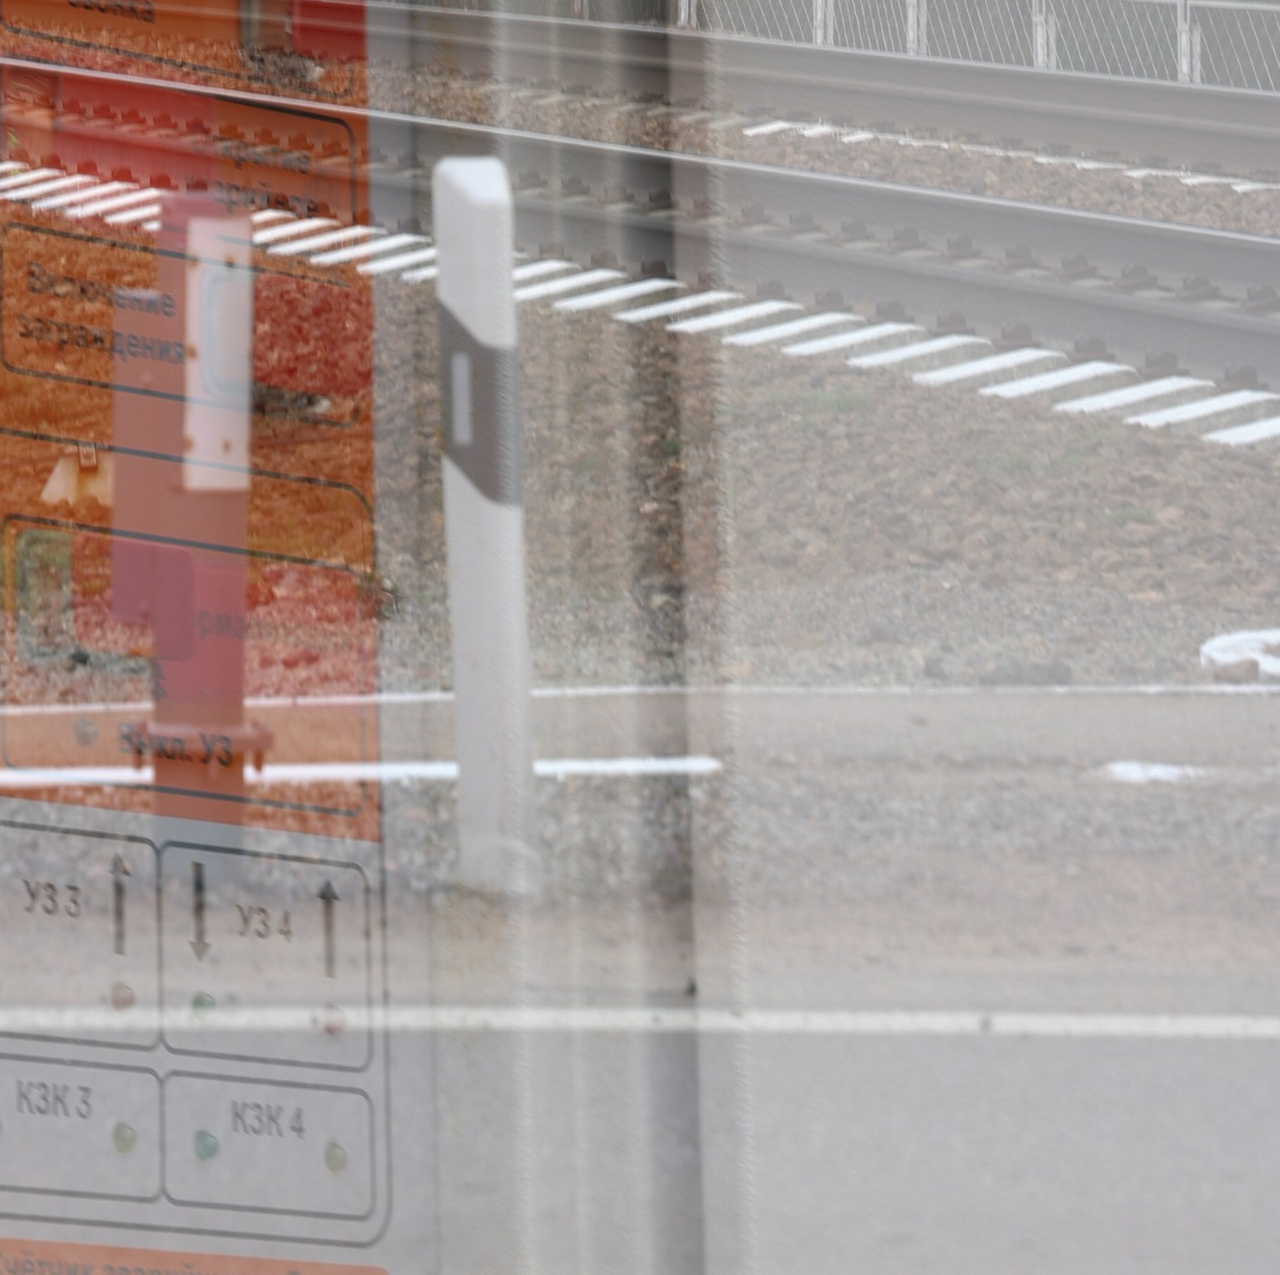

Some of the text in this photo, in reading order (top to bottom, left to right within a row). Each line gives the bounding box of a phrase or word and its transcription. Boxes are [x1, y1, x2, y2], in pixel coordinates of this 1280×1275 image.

[66, 885, 82, 919] 3
[278, 910, 294, 943] 4
[77, 1086, 93, 1120] 3
[289, 1108, 306, 1141] 4
